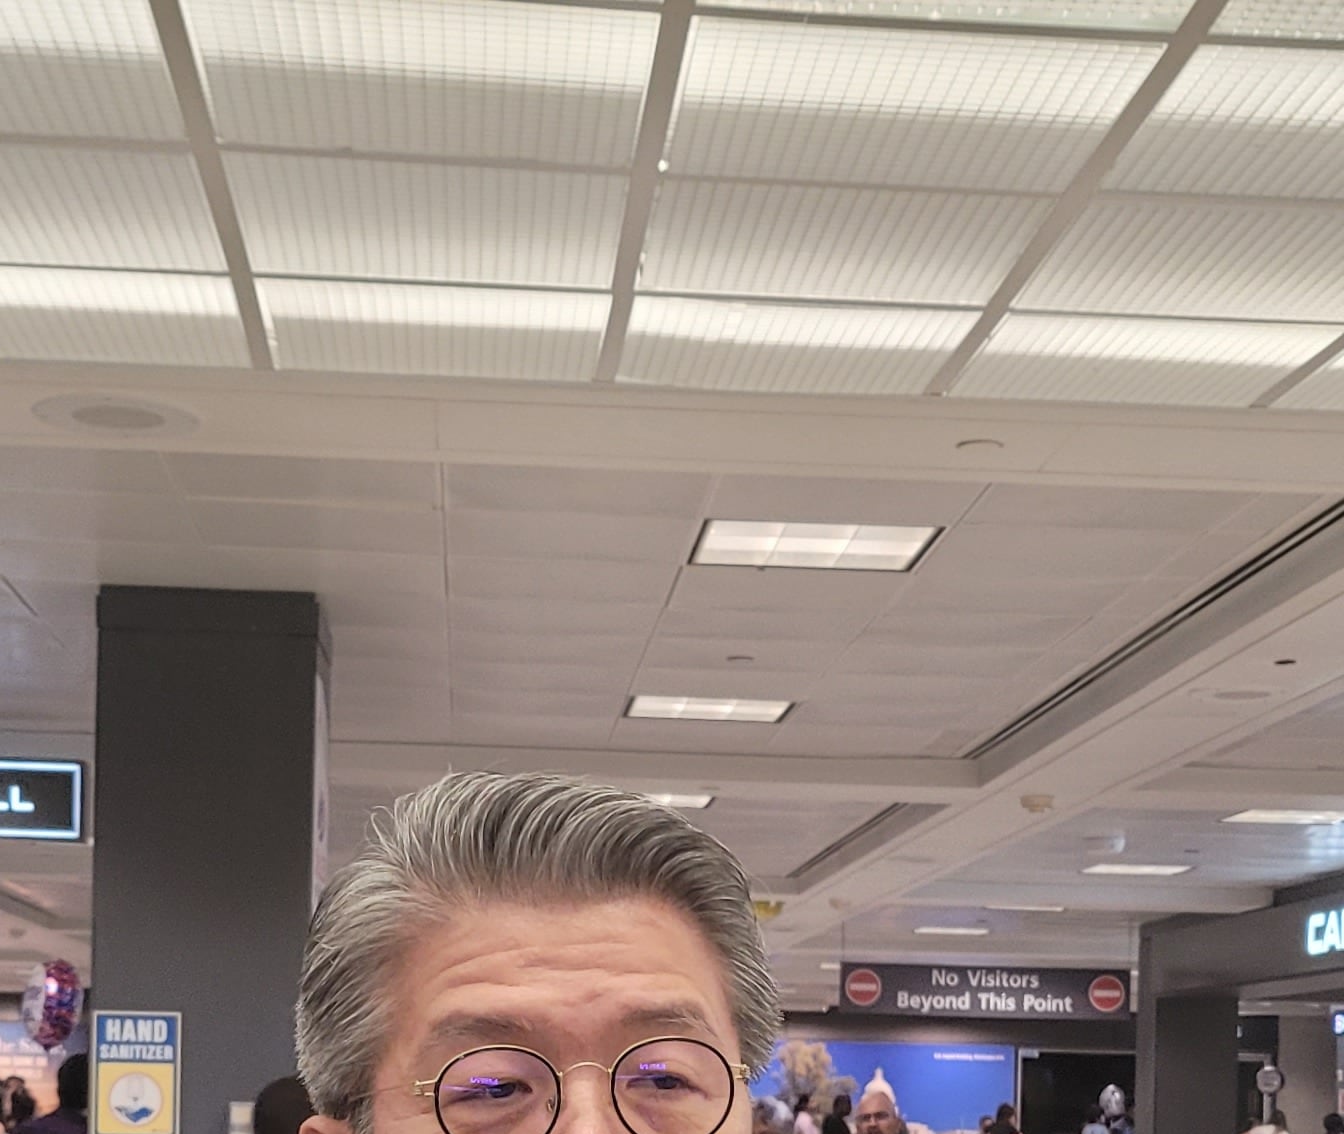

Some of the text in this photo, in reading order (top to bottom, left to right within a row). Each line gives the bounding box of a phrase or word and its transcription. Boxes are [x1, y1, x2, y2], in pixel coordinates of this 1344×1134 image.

[931, 969, 1040, 989] No Visitors
[896, 990, 1073, 1014] Beyond This Point
[105, 1018, 168, 1043] HAND
[99, 1044, 174, 1060] SANITIZER
